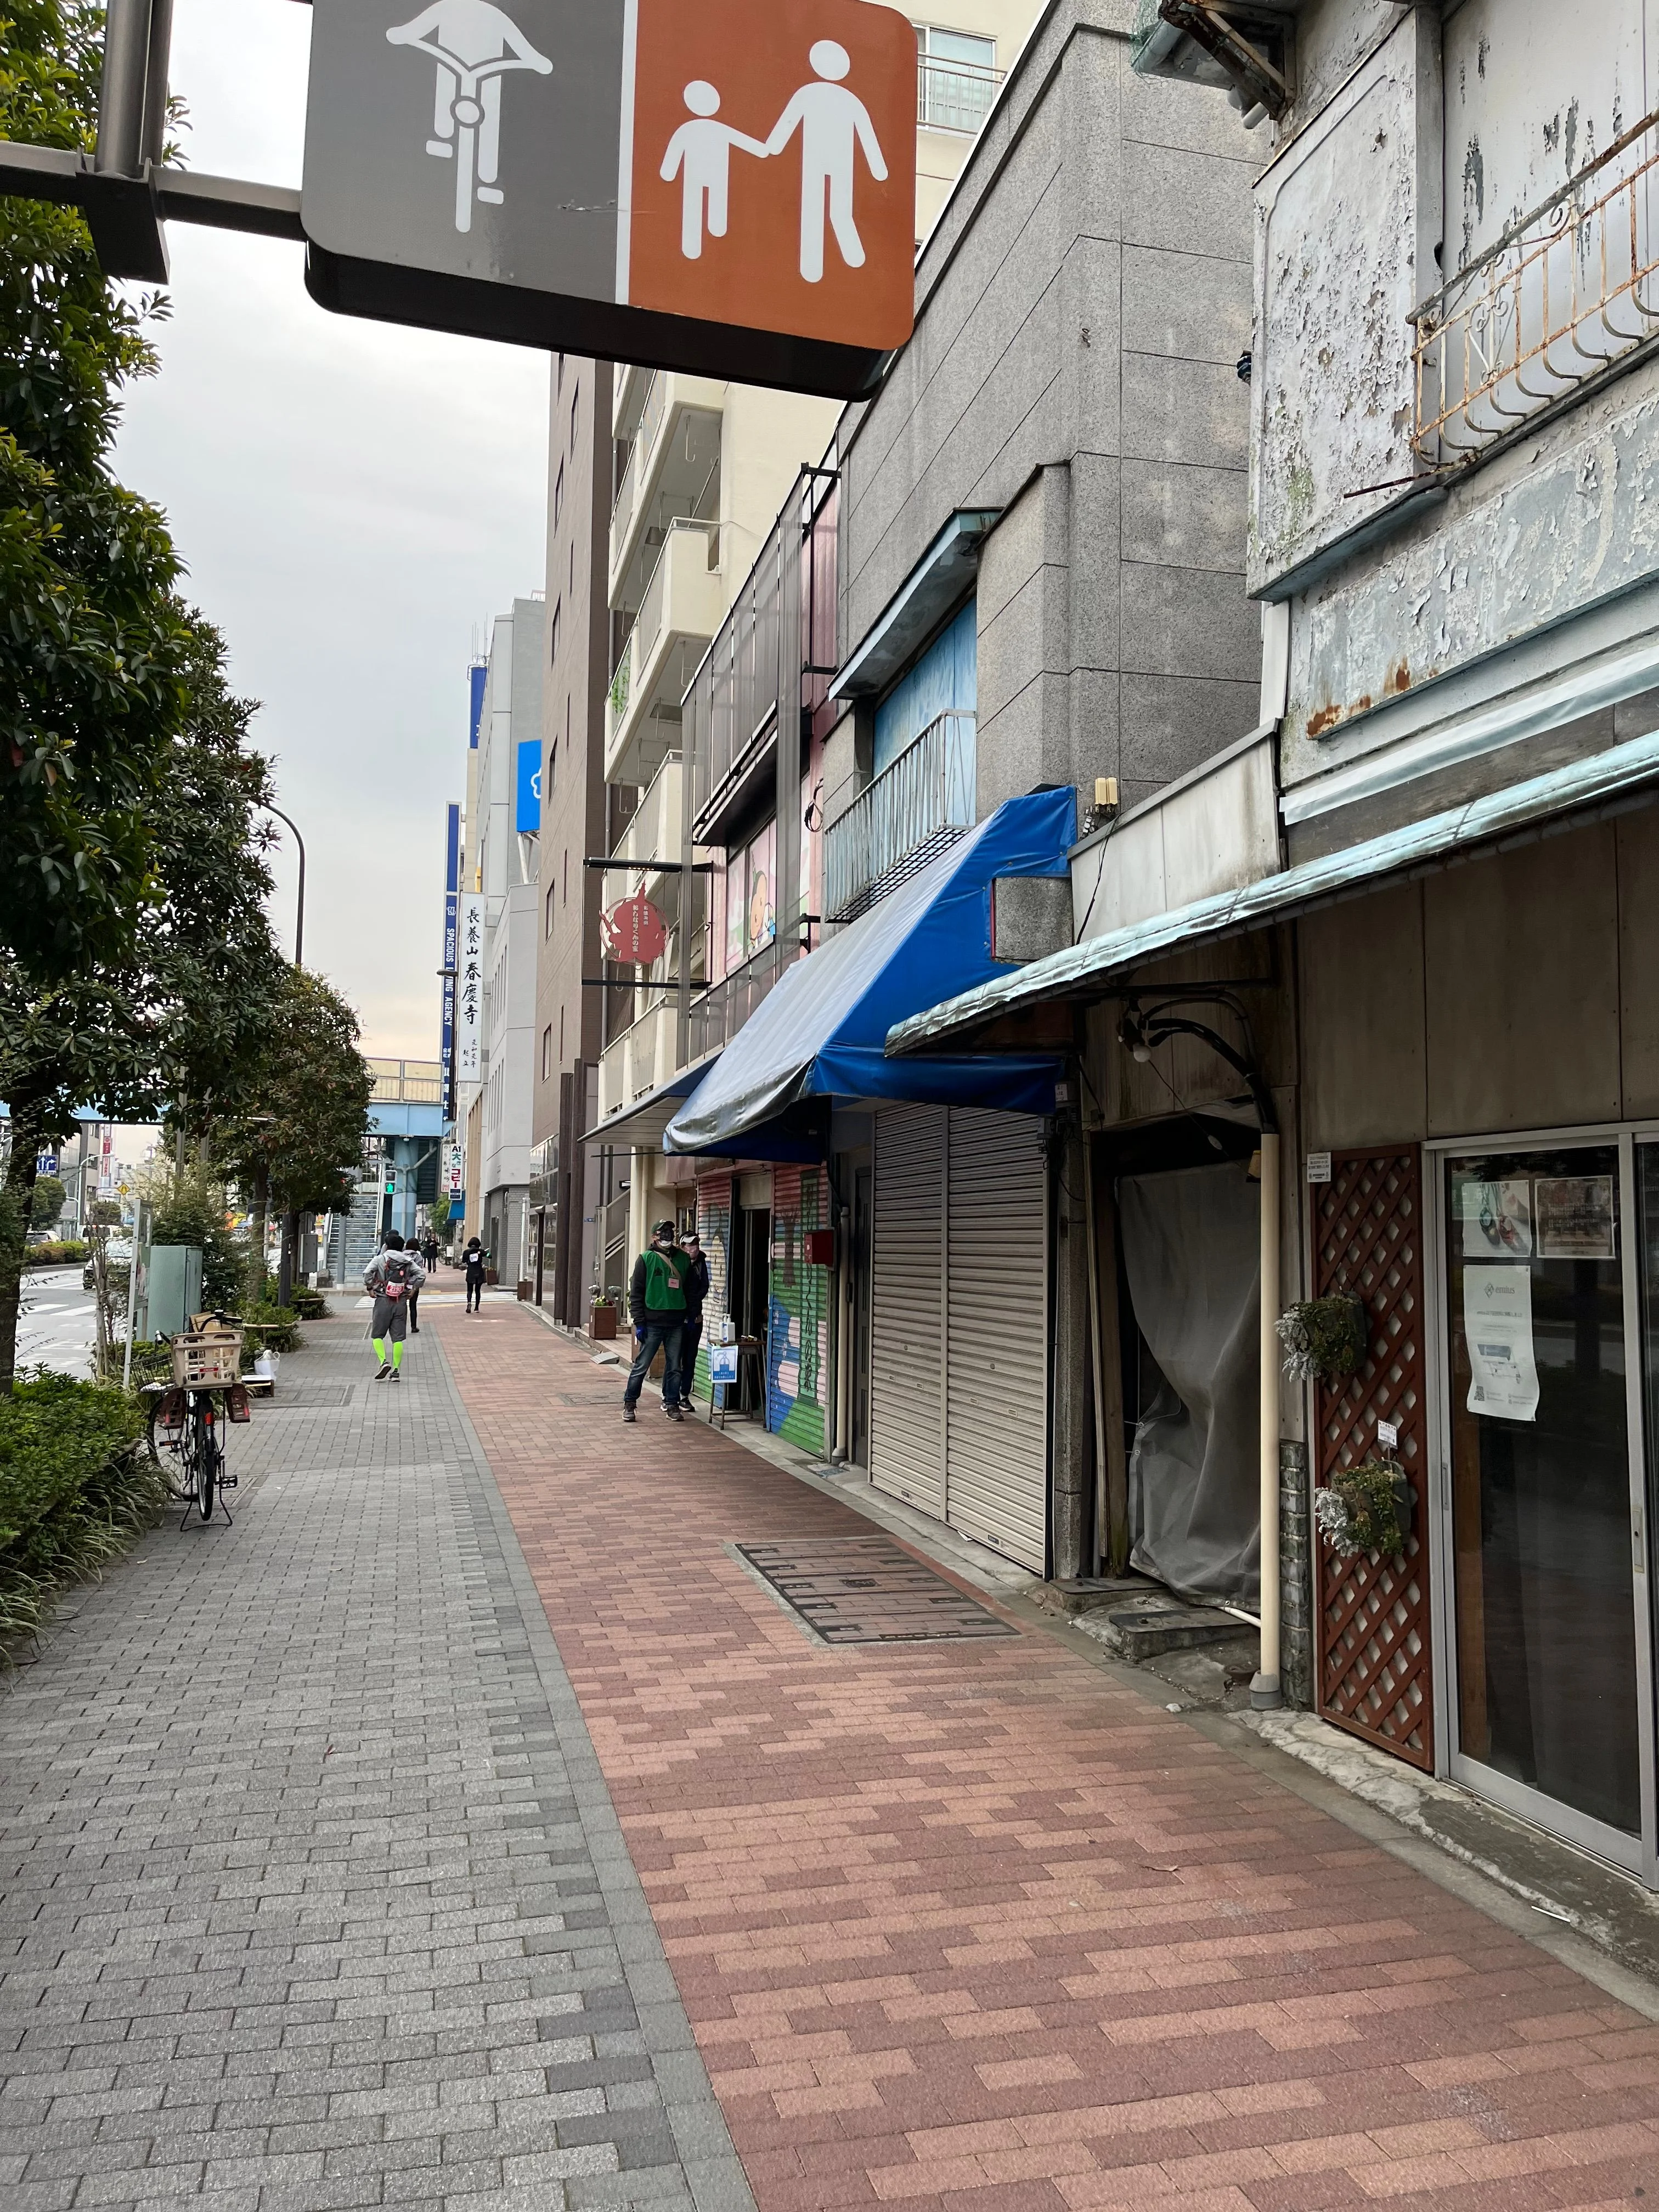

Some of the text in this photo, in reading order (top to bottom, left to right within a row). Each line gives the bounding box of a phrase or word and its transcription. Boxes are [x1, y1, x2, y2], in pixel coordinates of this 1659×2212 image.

[444, 928, 455, 1026] SPACIOUS LVING AGENCY
[461, 907, 481, 1025] 長養山春慶寺
